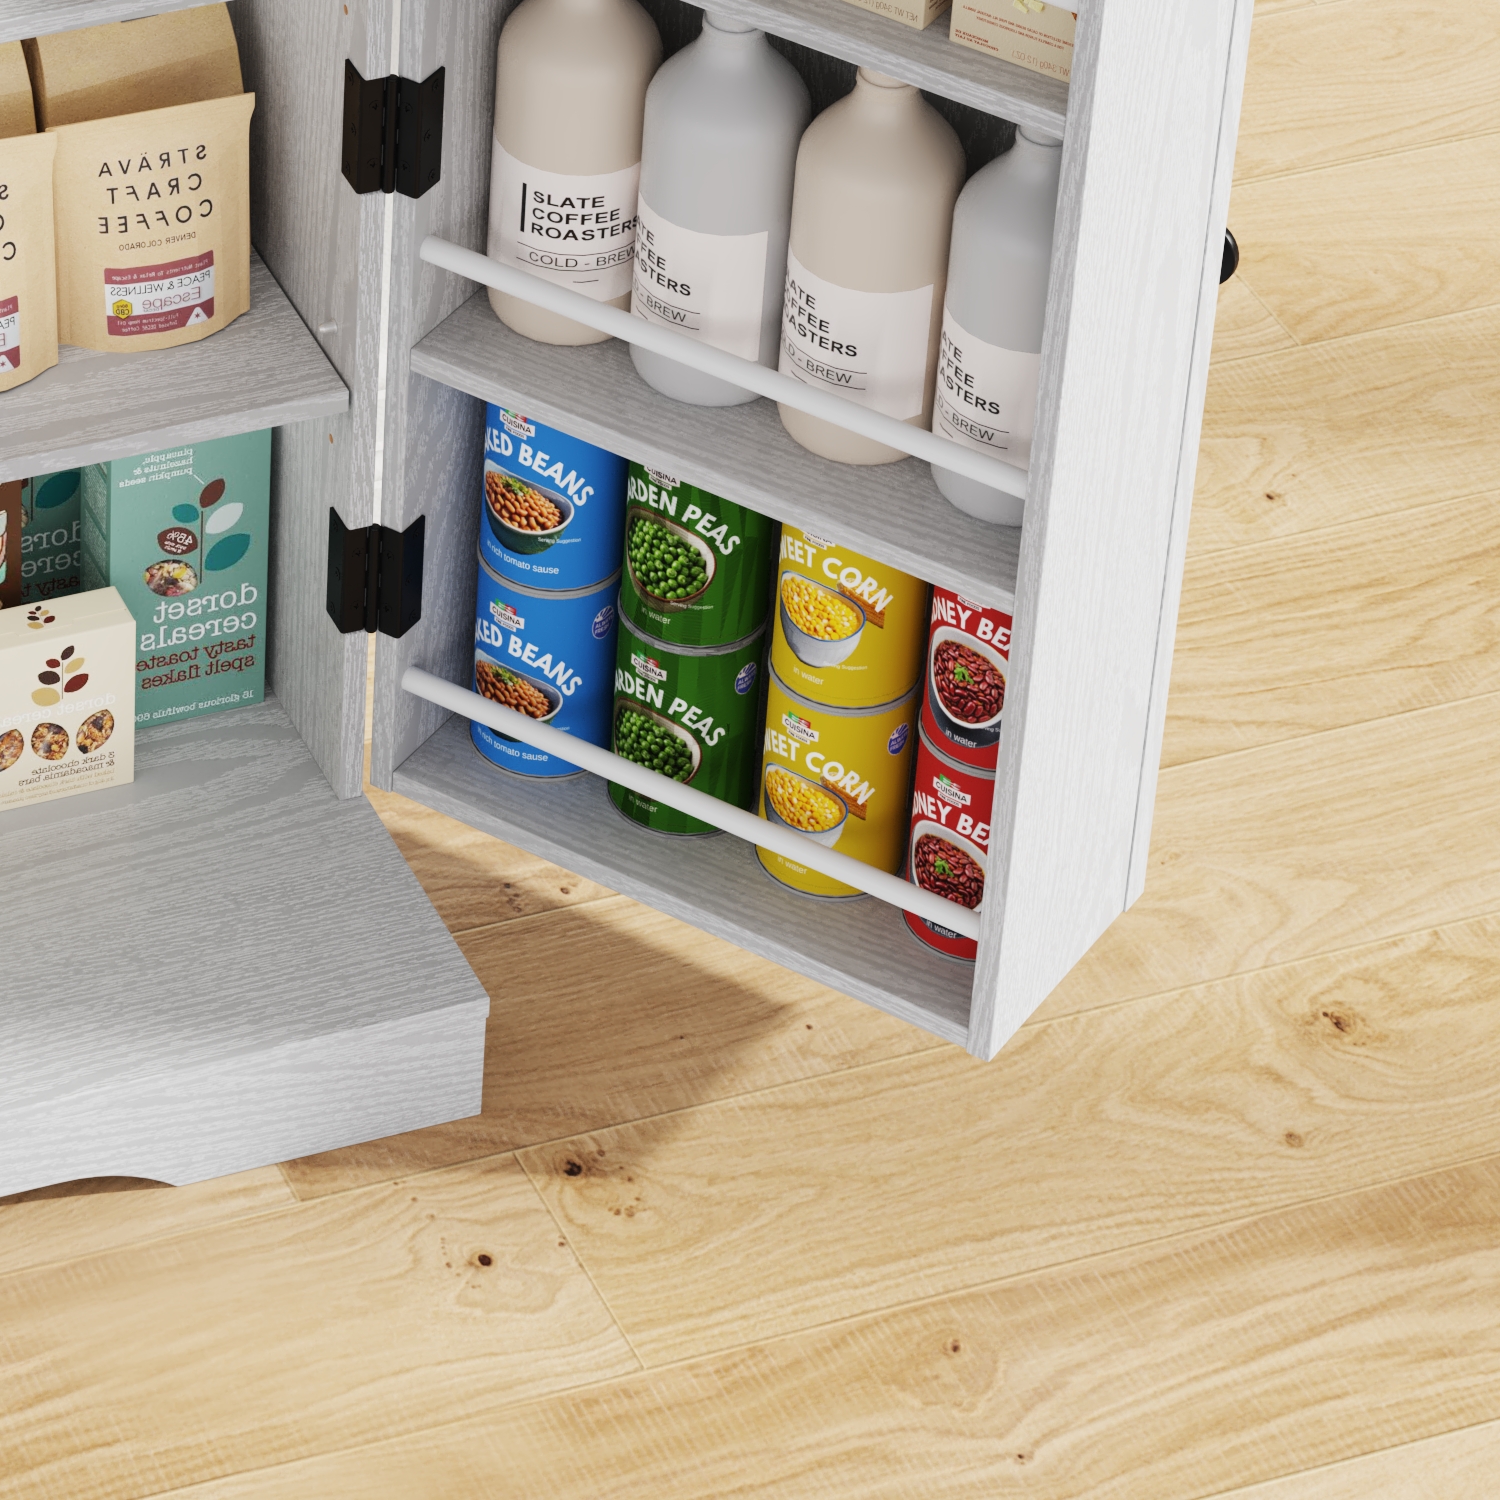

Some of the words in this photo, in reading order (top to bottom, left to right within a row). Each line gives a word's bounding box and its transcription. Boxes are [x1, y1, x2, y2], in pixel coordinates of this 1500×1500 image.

[533, 190, 605, 209] SLATE
[531, 214, 638, 241] ROASTERS
[532, 207, 620, 225] COFFEE
[529, 251, 578, 268] COLD
[596, 245, 636, 267] BREW
[646, 294, 687, 322] BREW
[806, 360, 852, 384] BREW
[501, 413, 531, 434] CUISINA
[952, 412, 994, 441] BREW
[518, 442, 594, 507] BEANS
[681, 504, 740, 555] PEAS
[503, 552, 530, 570] tomato
[533, 564, 559, 575] sause
[822, 557, 894, 613] CORN
[648, 609, 671, 624] water
[507, 634, 582, 696] BEANS
[633, 658, 663, 678] CUISINA
[801, 670, 824, 685] water
[667, 697, 726, 747] PEAS
[785, 718, 815, 739] CUISINA
[945, 727, 952, 738] in
[954, 732, 977, 748] water
[806, 752, 875, 805] CORN
[935, 781, 967, 803] CUISINA
